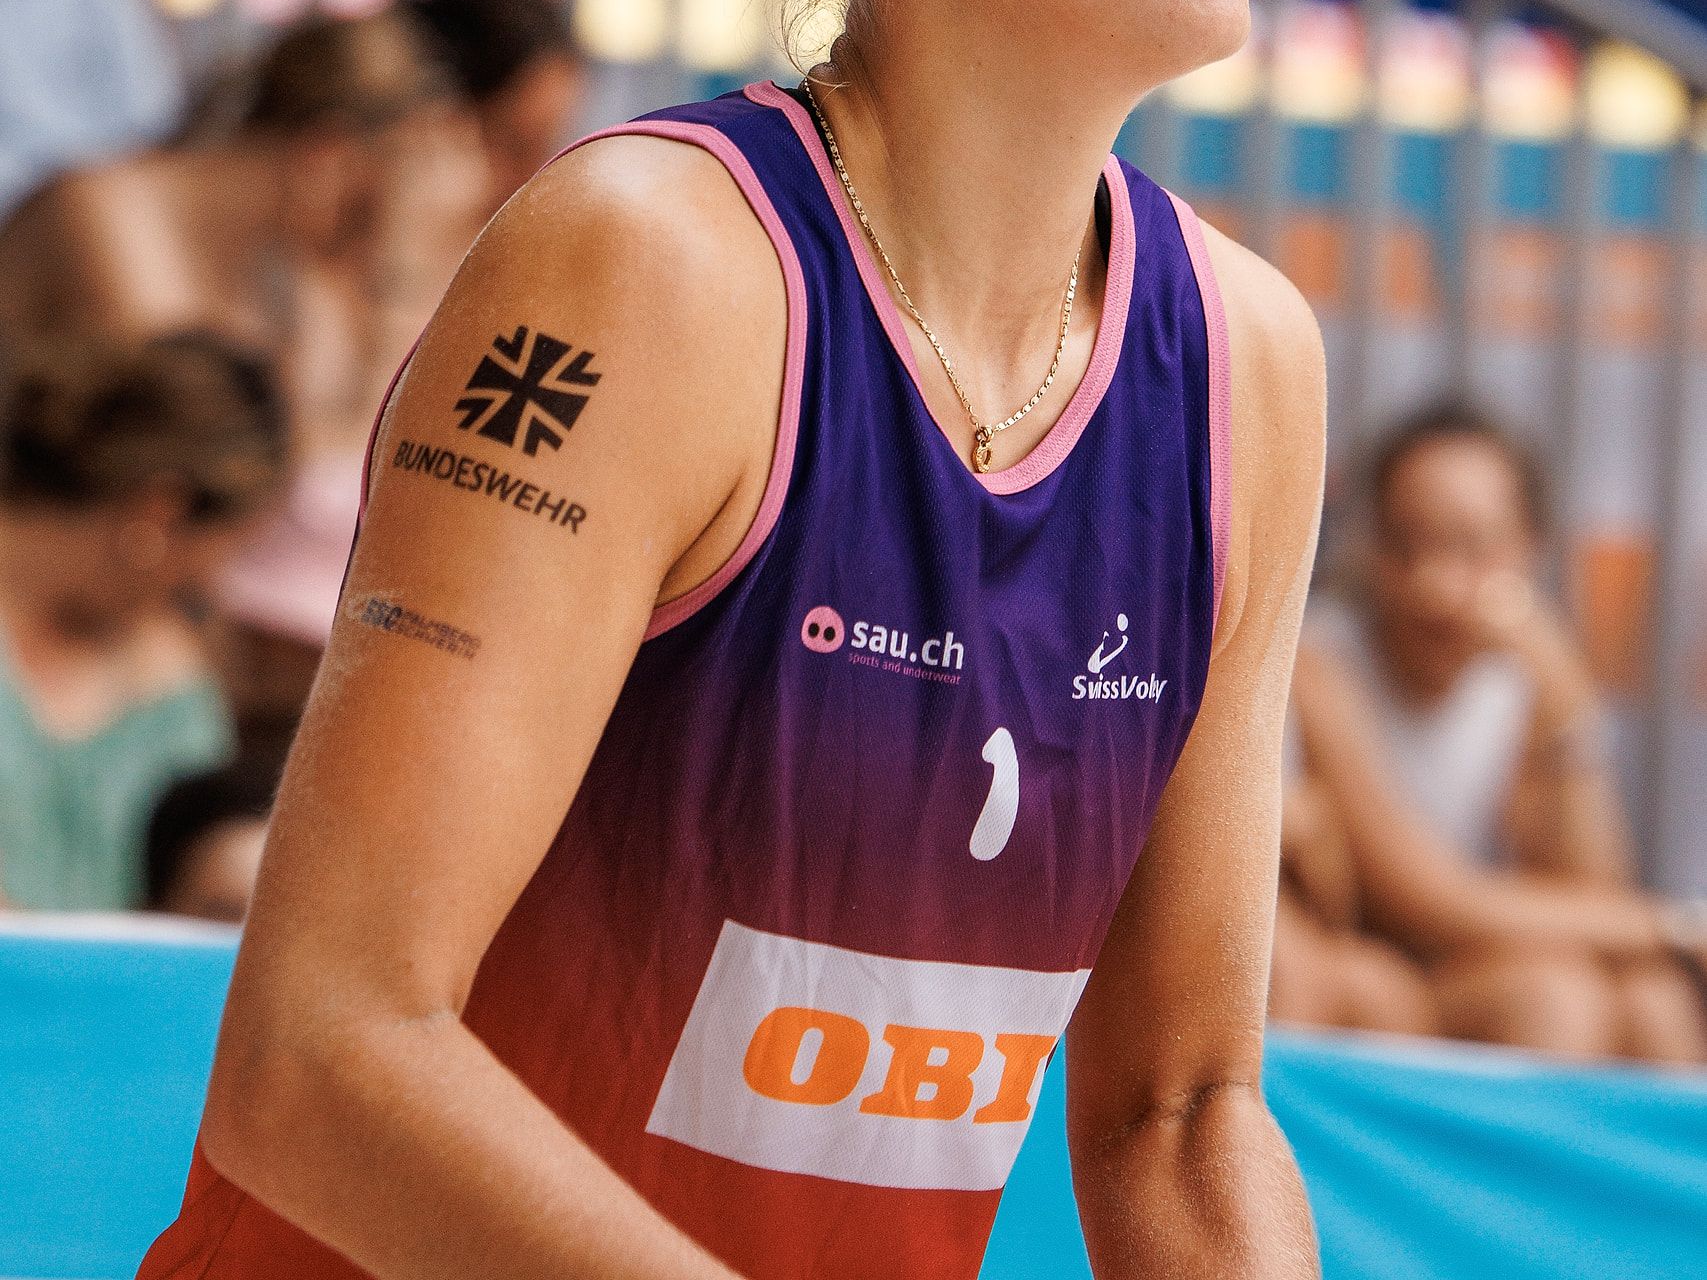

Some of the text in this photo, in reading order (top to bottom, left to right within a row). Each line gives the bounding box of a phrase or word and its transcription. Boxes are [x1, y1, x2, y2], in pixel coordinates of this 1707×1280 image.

[392, 440, 587, 535] BUNDESWEHR
[848, 653, 961, 685] sports and underwear
[850, 621, 964, 669] sau.ch
[969, 727, 1019, 861] 1
[742, 1006, 1057, 1124] OBI
